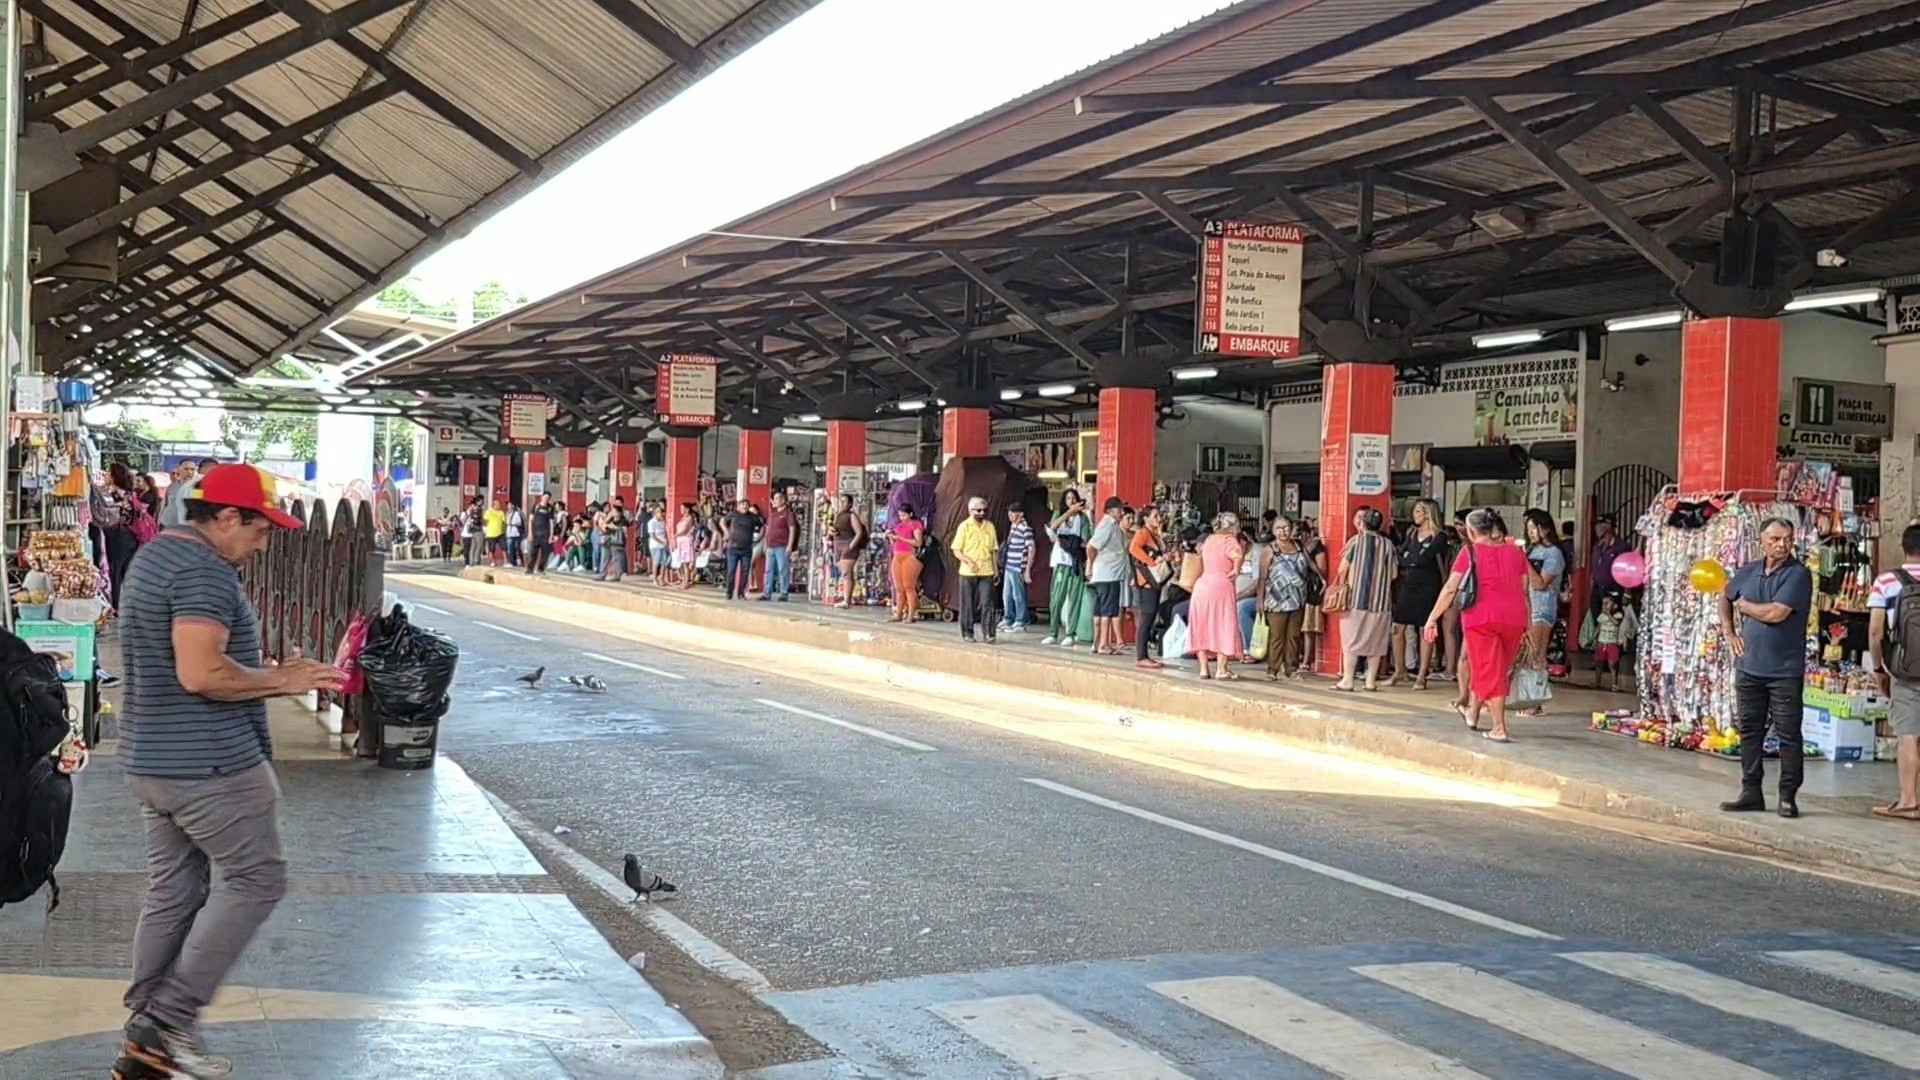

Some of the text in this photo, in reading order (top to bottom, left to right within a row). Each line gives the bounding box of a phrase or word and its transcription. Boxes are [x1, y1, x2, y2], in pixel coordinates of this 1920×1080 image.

[1227, 222, 1300, 240] PLATAFORMA
[1256, 270, 1264, 278] do
[1206, 280, 1218, 289] 104
[1206, 294, 1218, 302] 109
[1241, 297, 1262, 305] Benfica
[1206, 308, 1217, 316] 117
[1240, 311, 1260, 319] Jardim
[1239, 323, 1259, 331] Jardim
[1230, 337, 1290, 356] EMBARQUE
[673, 354, 715, 363] PLATAFORMA
[1495, 385, 1559, 407] Cantinho
[1838, 399, 1872, 411] PRAÇA DE
[676, 416, 711, 424] EMBARQUE
[1504, 406, 1559, 426] Lanche
[1838, 412, 1886, 425] ALIMENTAÇÃO
[1790, 430, 1852, 445] Lanche
